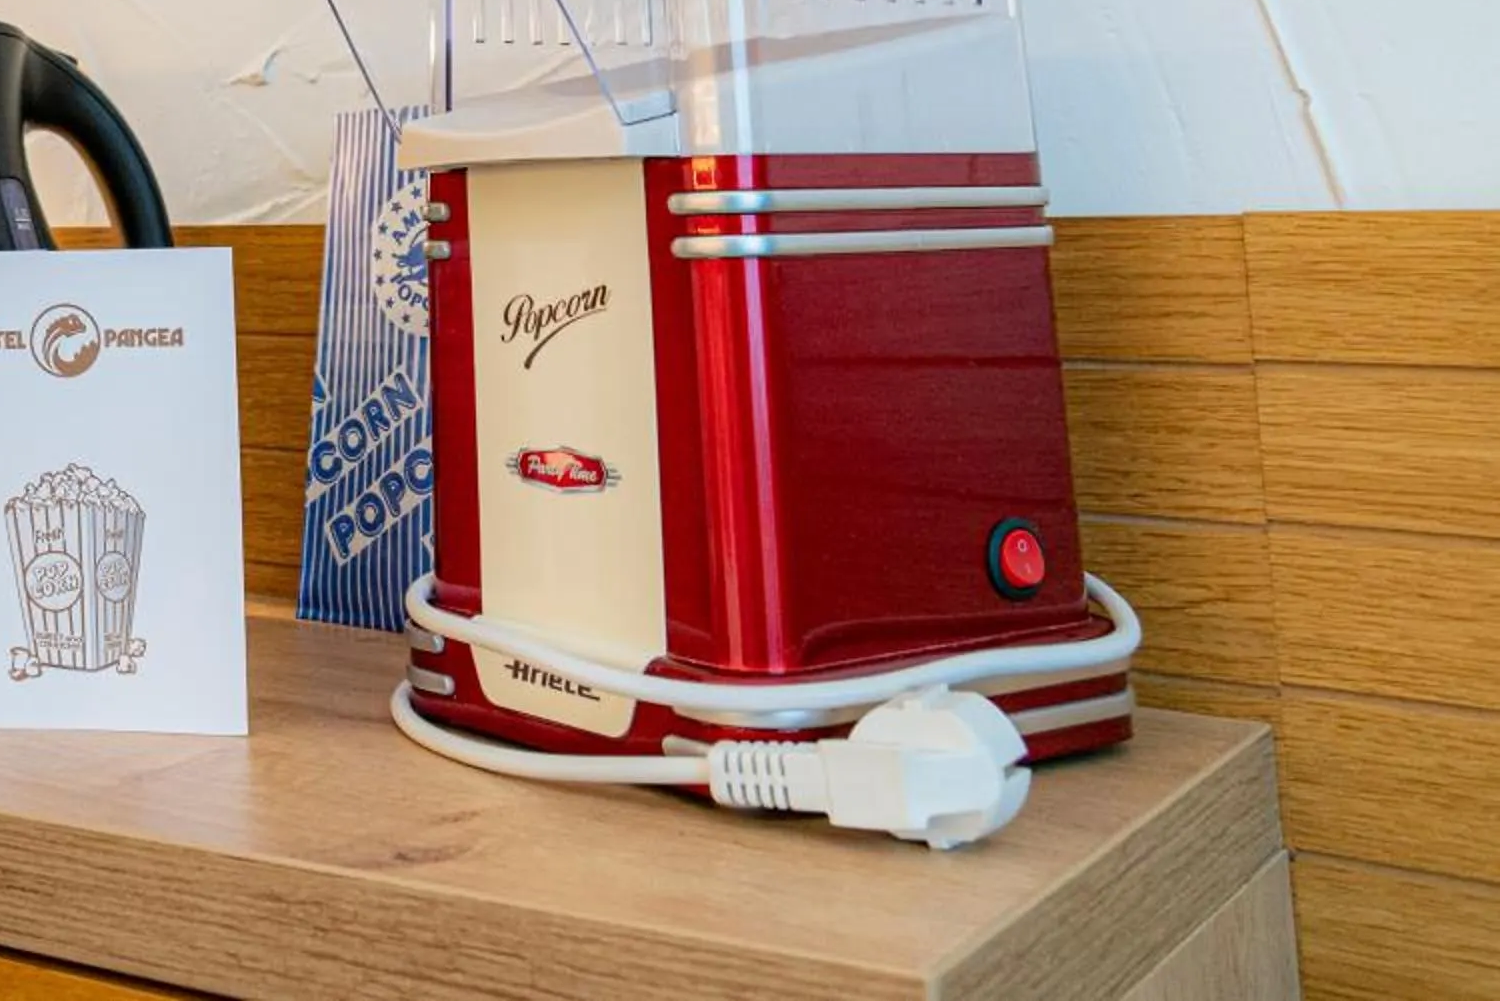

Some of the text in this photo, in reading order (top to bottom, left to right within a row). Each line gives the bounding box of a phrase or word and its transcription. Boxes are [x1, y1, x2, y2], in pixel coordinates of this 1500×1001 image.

[103, 326, 184, 348] PANGEA
[501, 283, 608, 344] Popcorn
[311, 372, 417, 485] CORN
